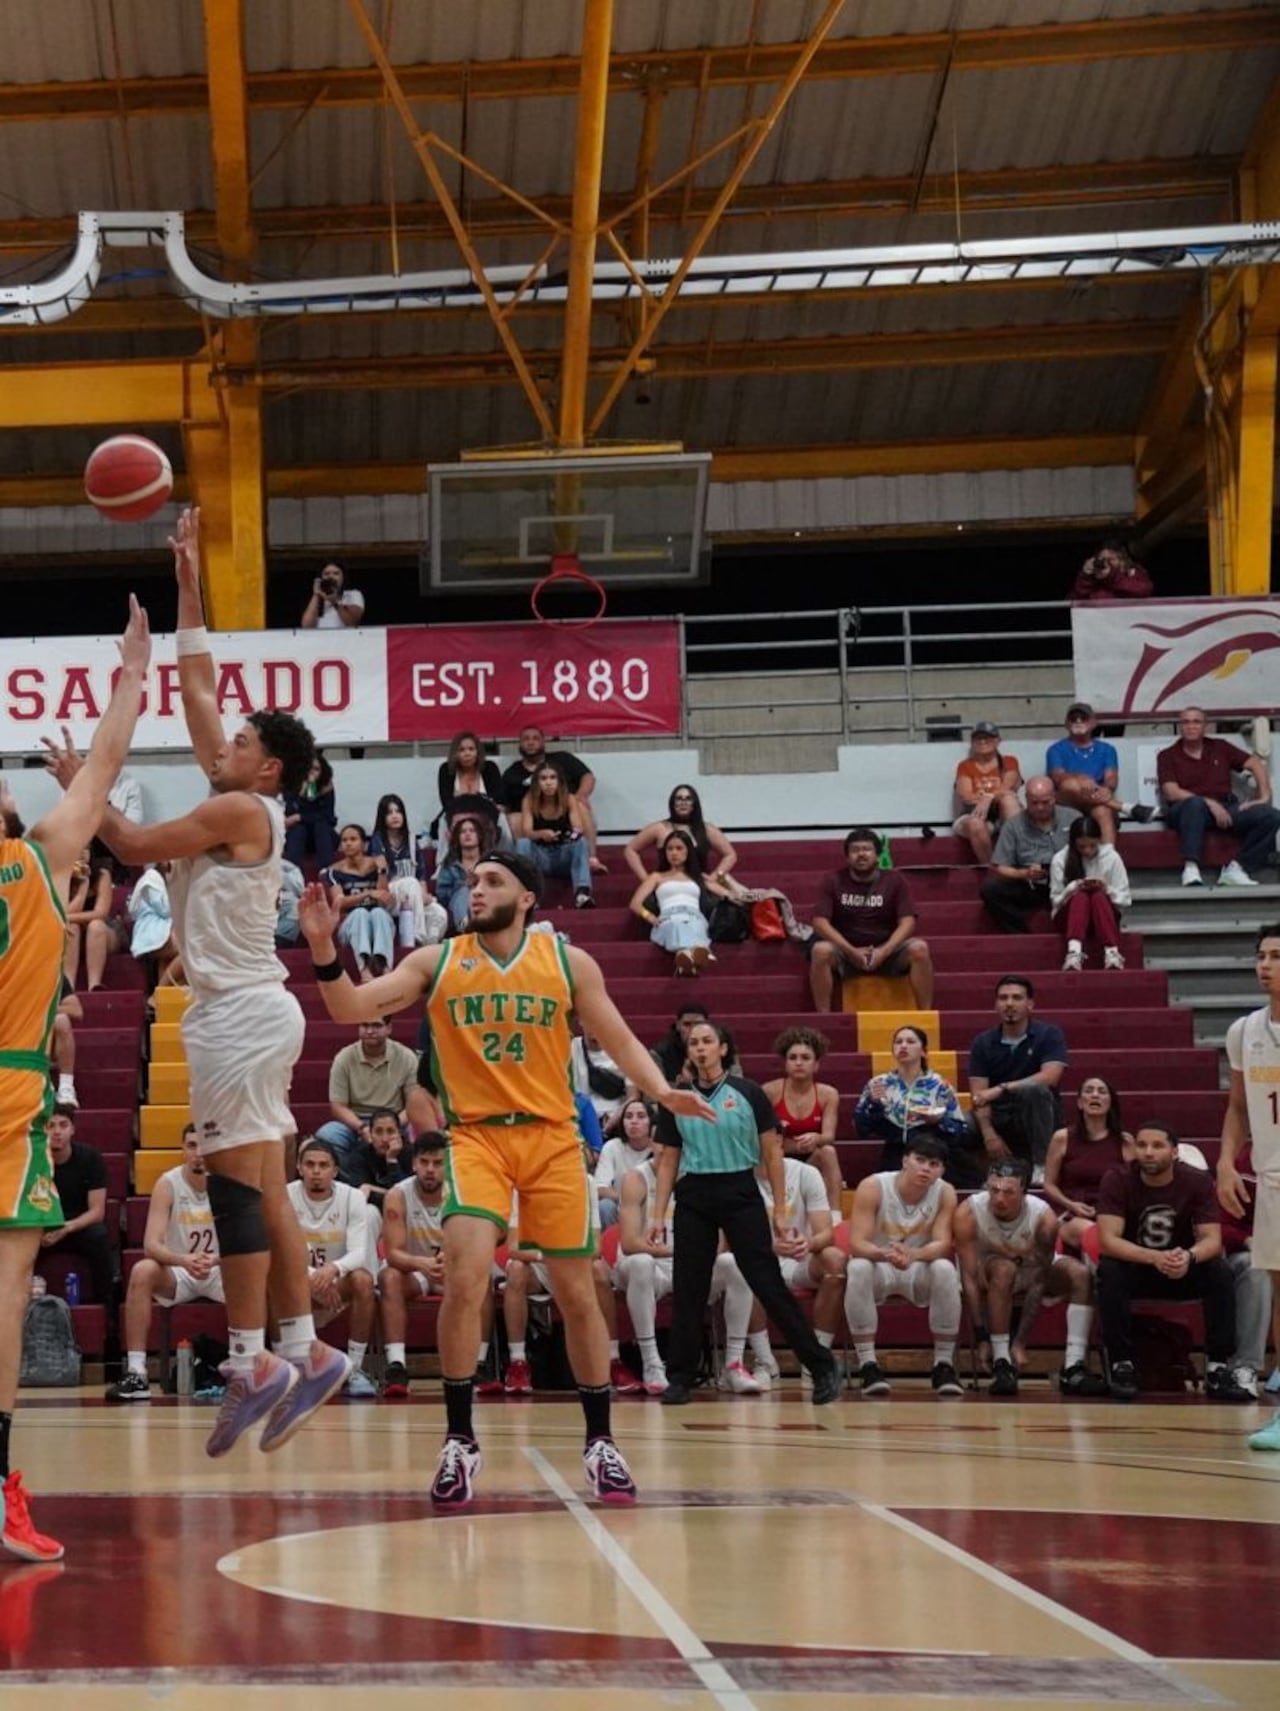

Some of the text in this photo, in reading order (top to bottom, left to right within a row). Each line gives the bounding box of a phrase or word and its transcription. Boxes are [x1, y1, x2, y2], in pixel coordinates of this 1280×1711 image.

[412, 658, 650, 706] EST. 1880
[447, 992, 559, 1028] INTER
[482, 1032, 526, 1064] 24
[189, 1229, 214, 1254] 22
